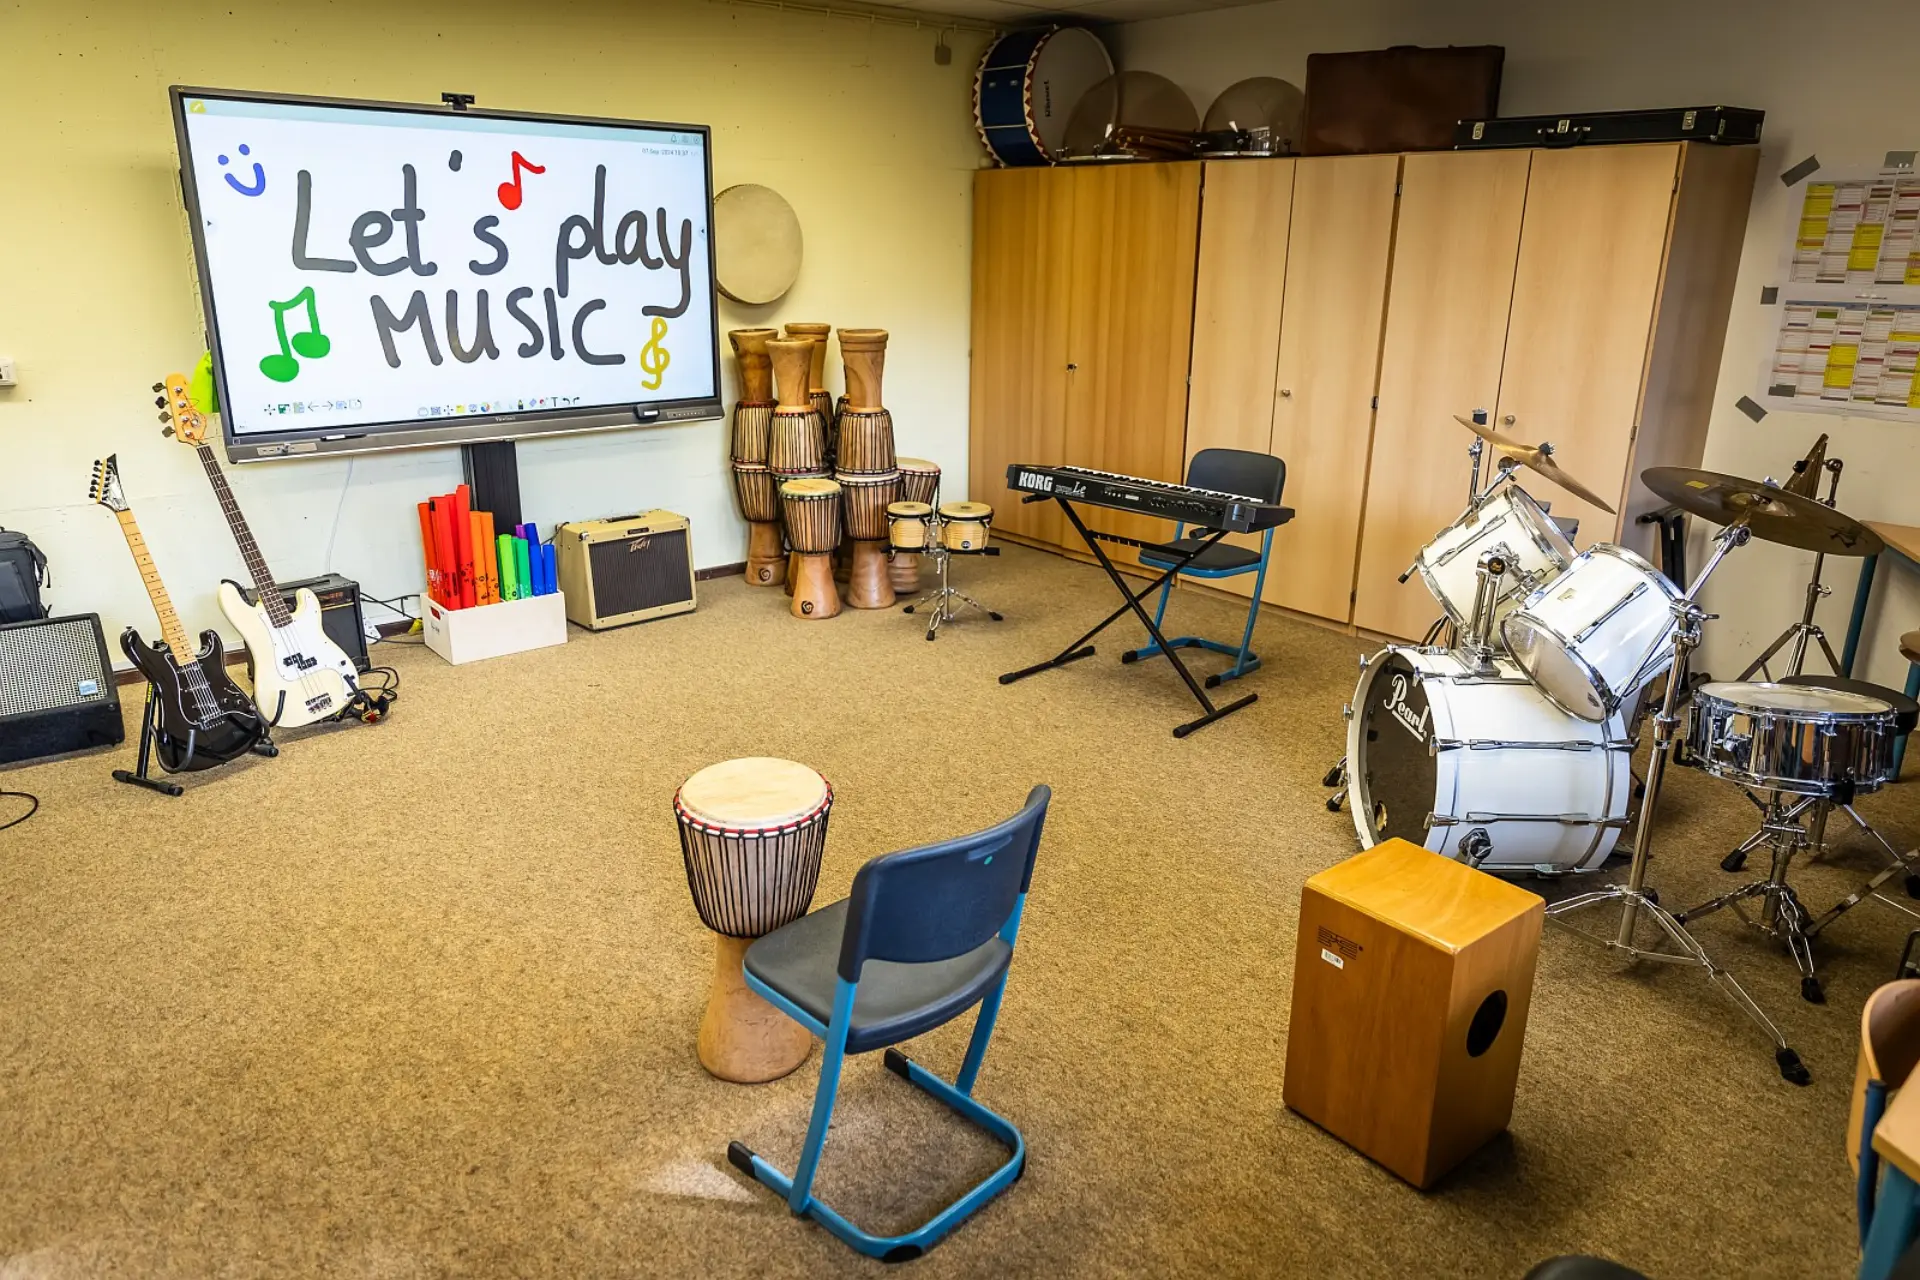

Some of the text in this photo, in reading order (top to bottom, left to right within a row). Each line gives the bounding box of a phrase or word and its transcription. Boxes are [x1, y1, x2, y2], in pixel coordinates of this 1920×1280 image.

[292, 149, 692, 319] Let's play
[369, 286, 626, 369] MUSIC
[1018, 471, 1054, 492] KORG
[1383, 673, 1430, 734] Pearl
